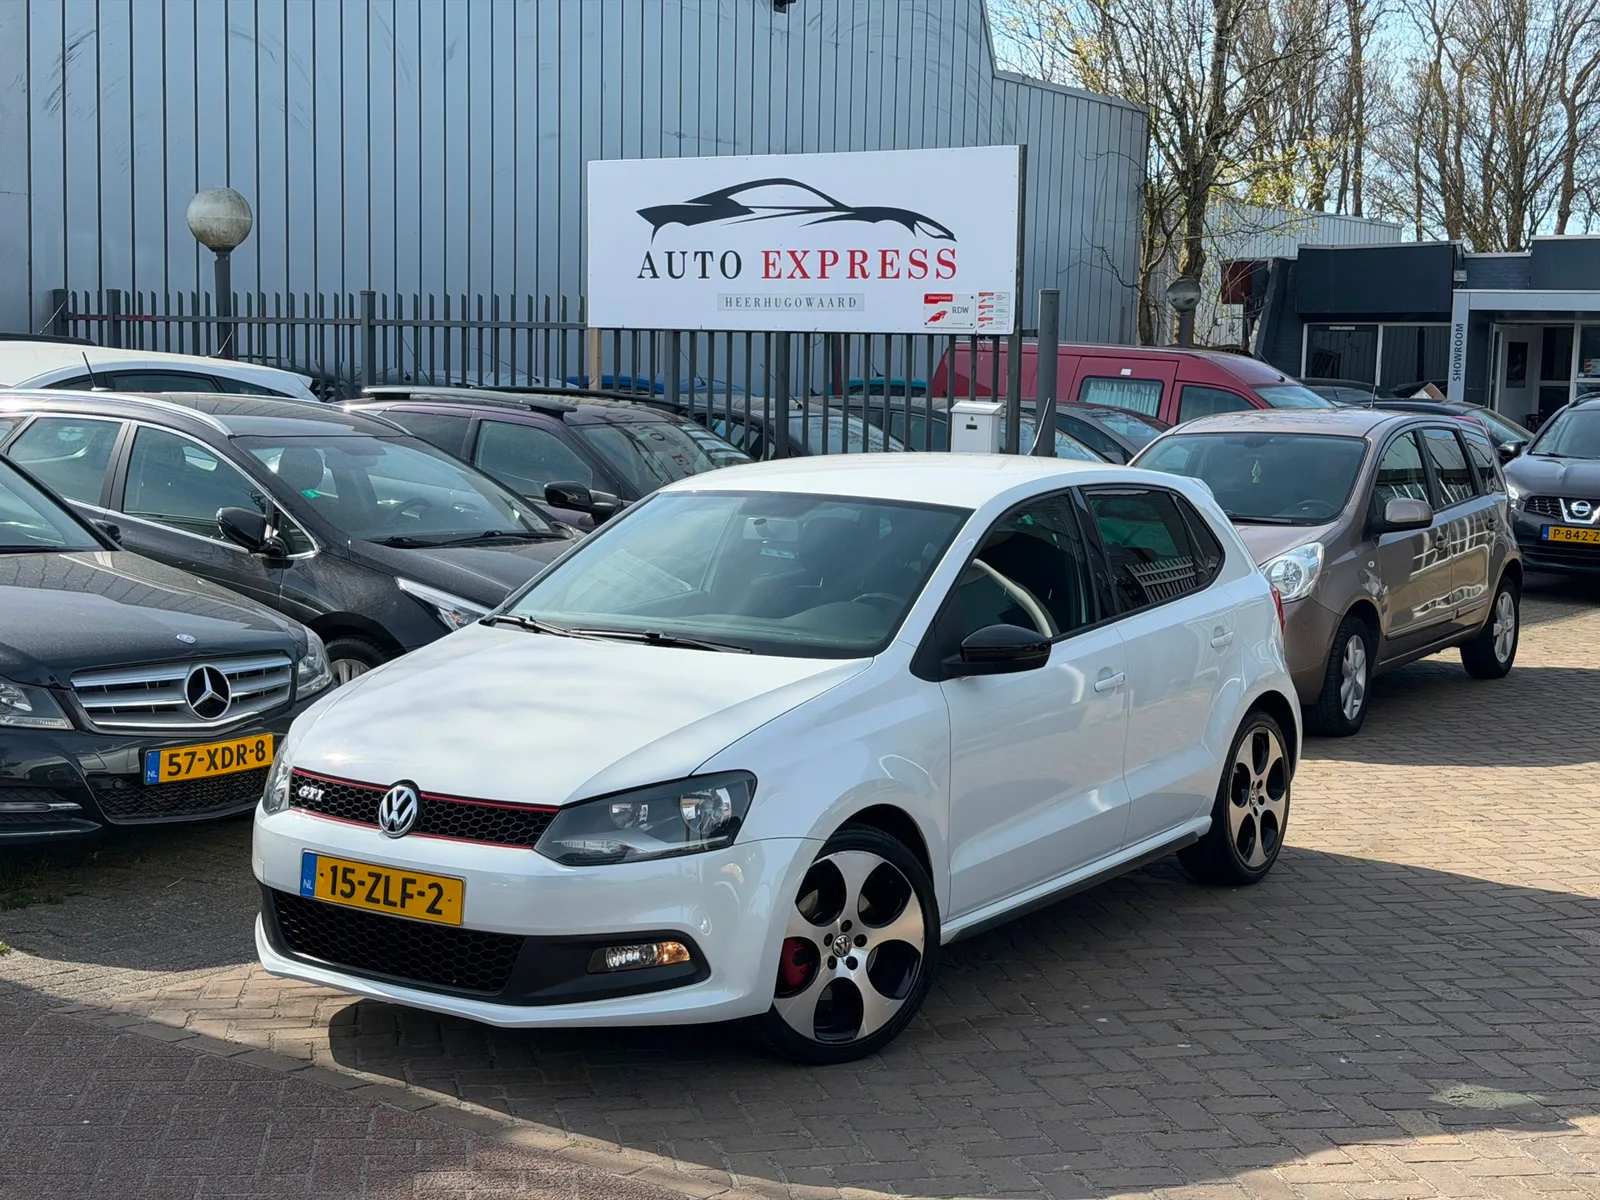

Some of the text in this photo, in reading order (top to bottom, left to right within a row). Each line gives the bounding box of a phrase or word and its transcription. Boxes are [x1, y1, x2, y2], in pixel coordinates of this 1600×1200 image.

[636, 248, 958, 280] AUTO EXPRESS
[724, 296, 858, 309] HEERHUGOWAARD
[951, 306, 970, 314] RDW
[1452, 323, 1464, 382] SHOWROOM
[1553, 528, 1600, 542] P-842-Z
[167, 739, 266, 777] 57-XDR-8
[147, 770, 158, 778] NL
[298, 785, 325, 801] GTI
[302, 879, 313, 890] NL
[330, 865, 444, 916] 15-ZLF-2
